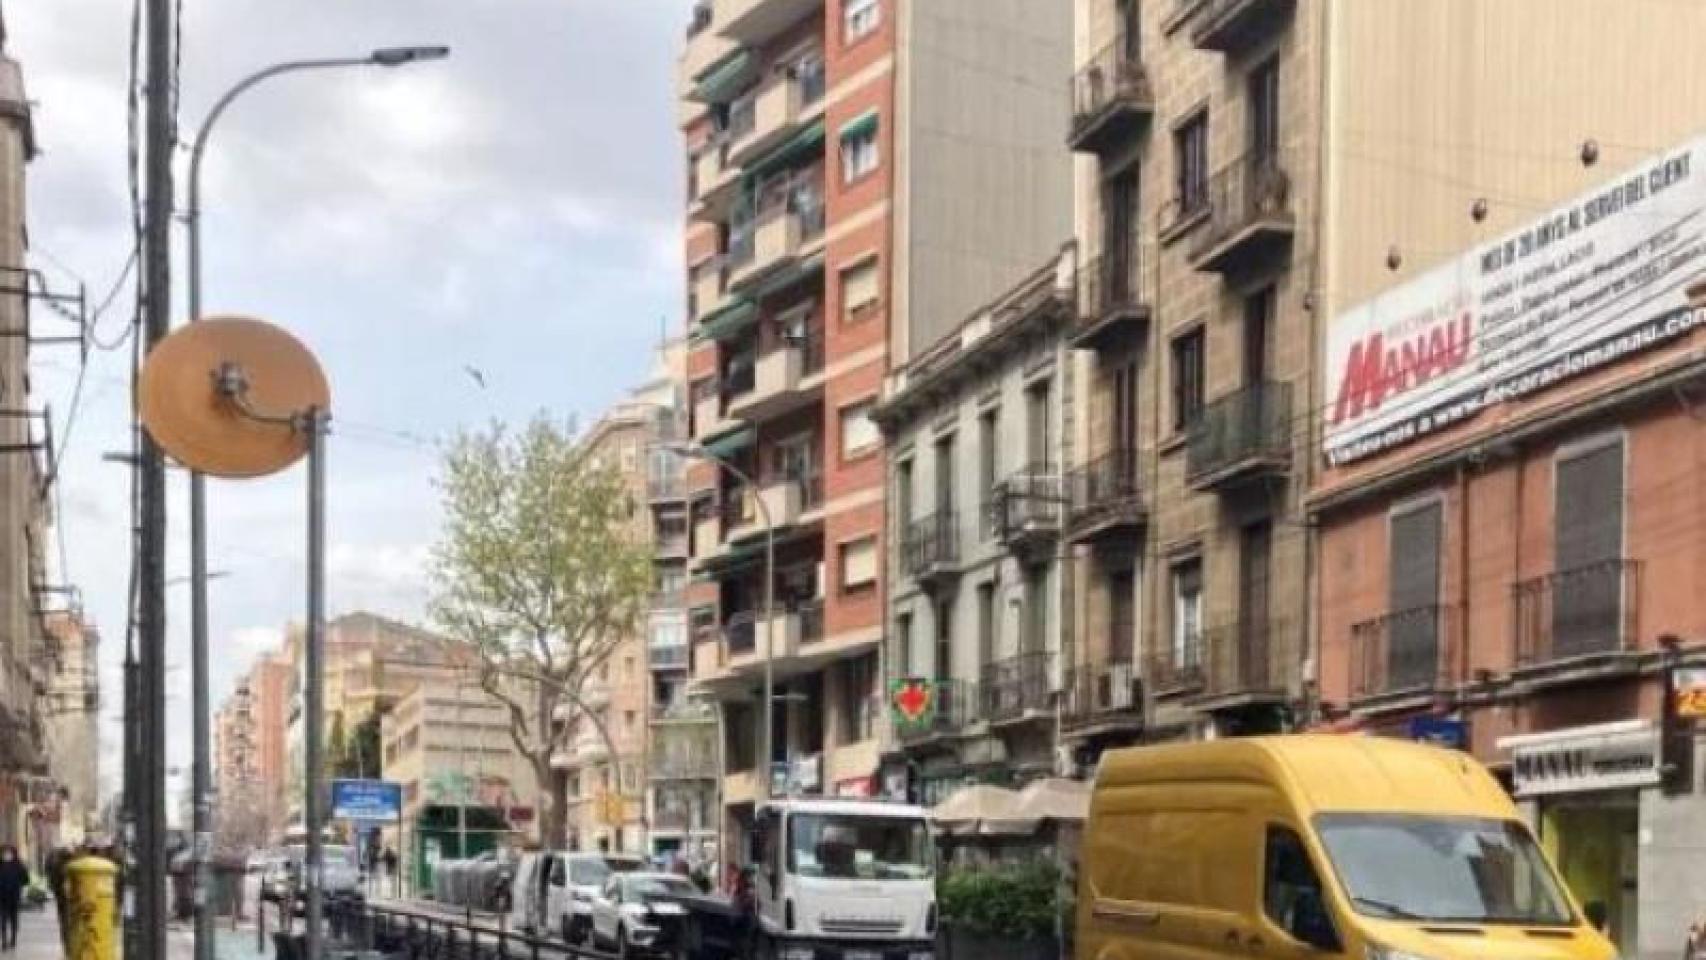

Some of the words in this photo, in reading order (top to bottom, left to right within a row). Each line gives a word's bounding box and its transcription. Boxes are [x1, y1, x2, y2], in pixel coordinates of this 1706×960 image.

[1650, 151, 1690, 195] CLIENT
[1333, 310, 1472, 425] MANAU
[1515, 750, 1586, 781] MANAU
